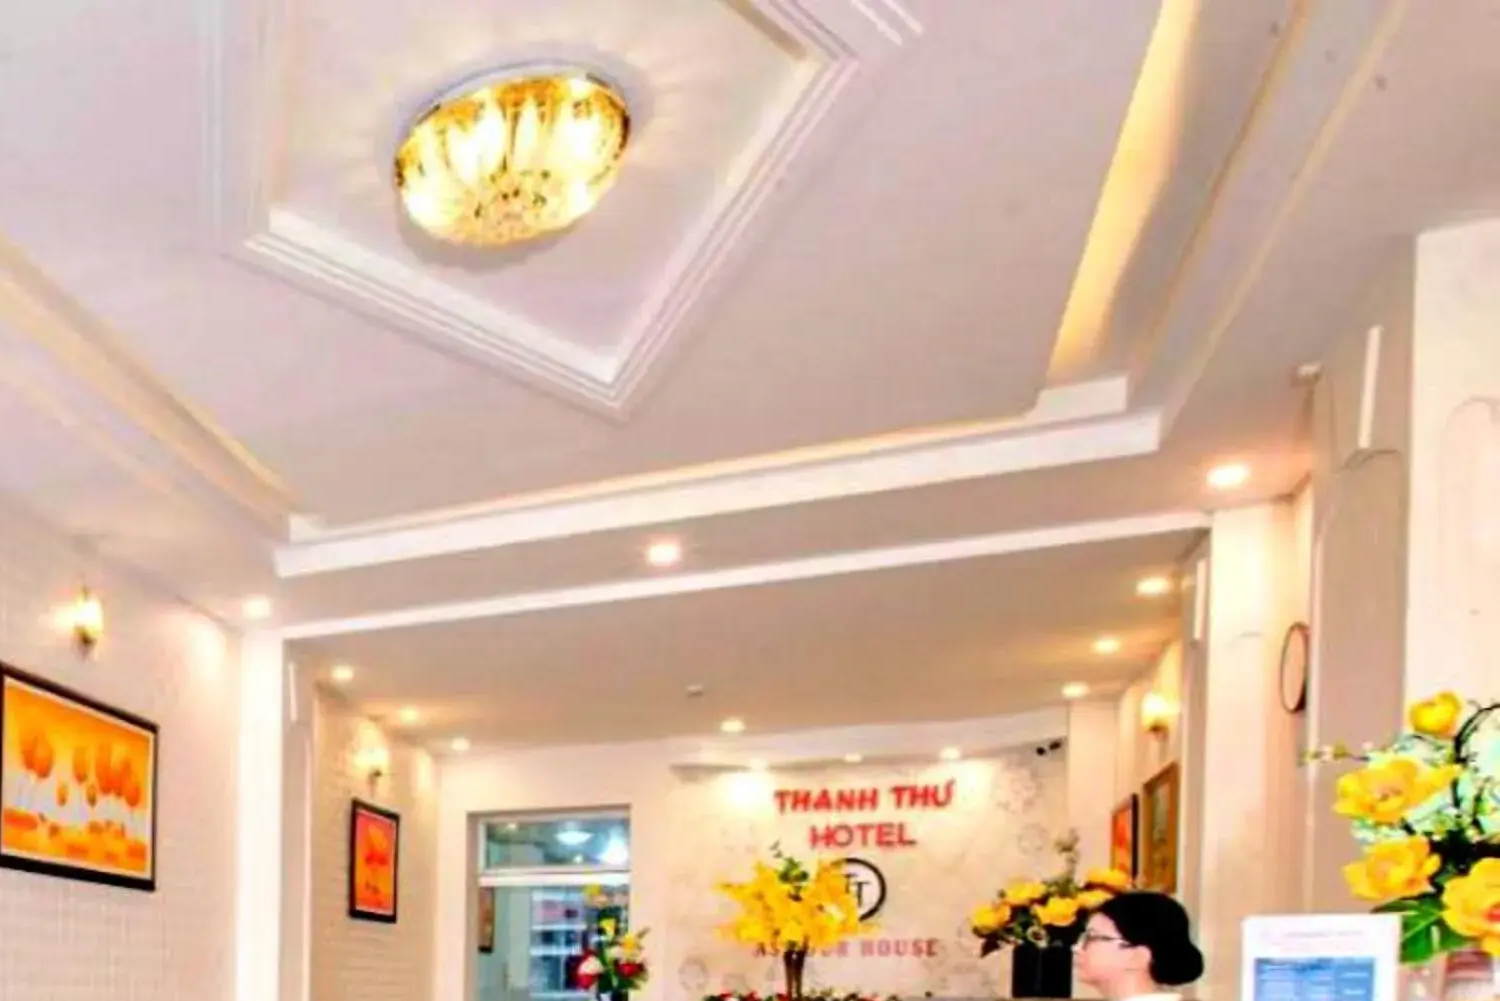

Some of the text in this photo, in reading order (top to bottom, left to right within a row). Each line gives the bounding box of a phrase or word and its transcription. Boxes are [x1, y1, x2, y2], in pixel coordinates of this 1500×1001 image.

[774, 787, 879, 813] THANH
[809, 822, 917, 849] HOTEL
[860, 938, 938, 957] HOUSE
